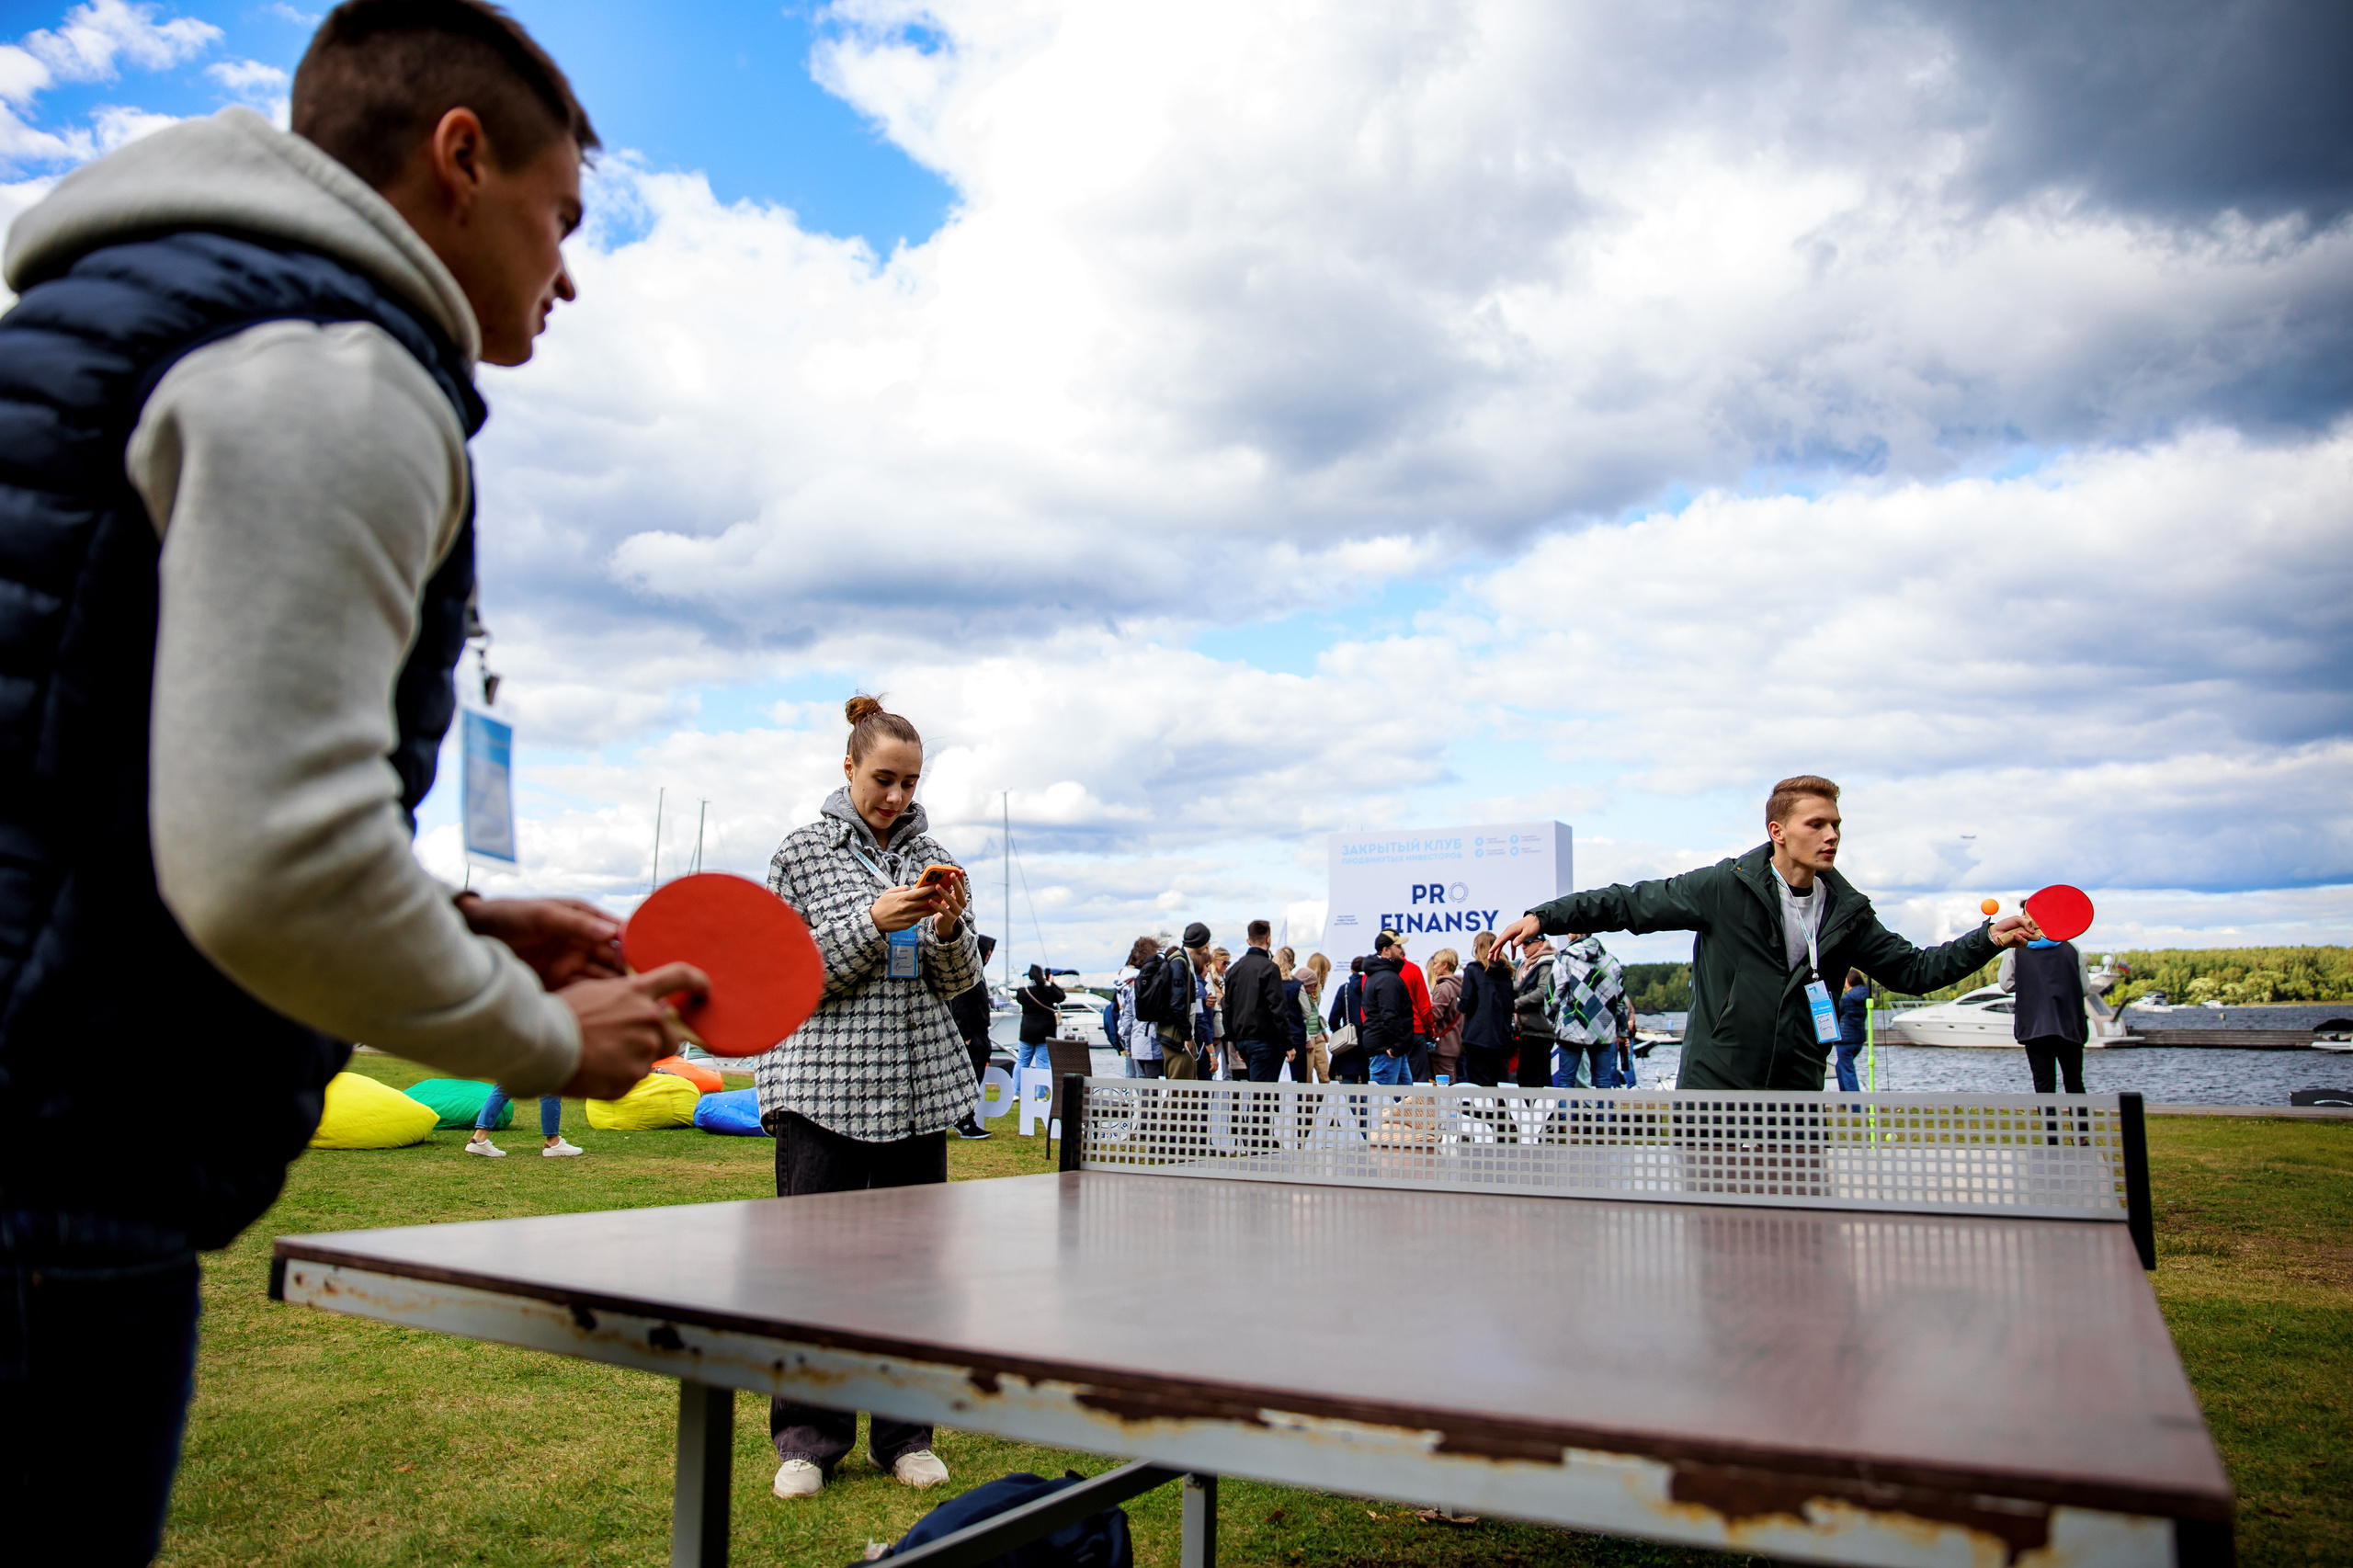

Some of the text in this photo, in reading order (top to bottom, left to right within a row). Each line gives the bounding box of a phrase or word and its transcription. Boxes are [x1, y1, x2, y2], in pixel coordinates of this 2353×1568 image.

[1342, 837, 1462, 856] ЗАКРЫТЫЙ КЛУБ
[1342, 852, 1462, 865] ПРОДВИНУТЫХ ИНВЕСТОРОВ
[1381, 910, 1499, 933] FINANSY
